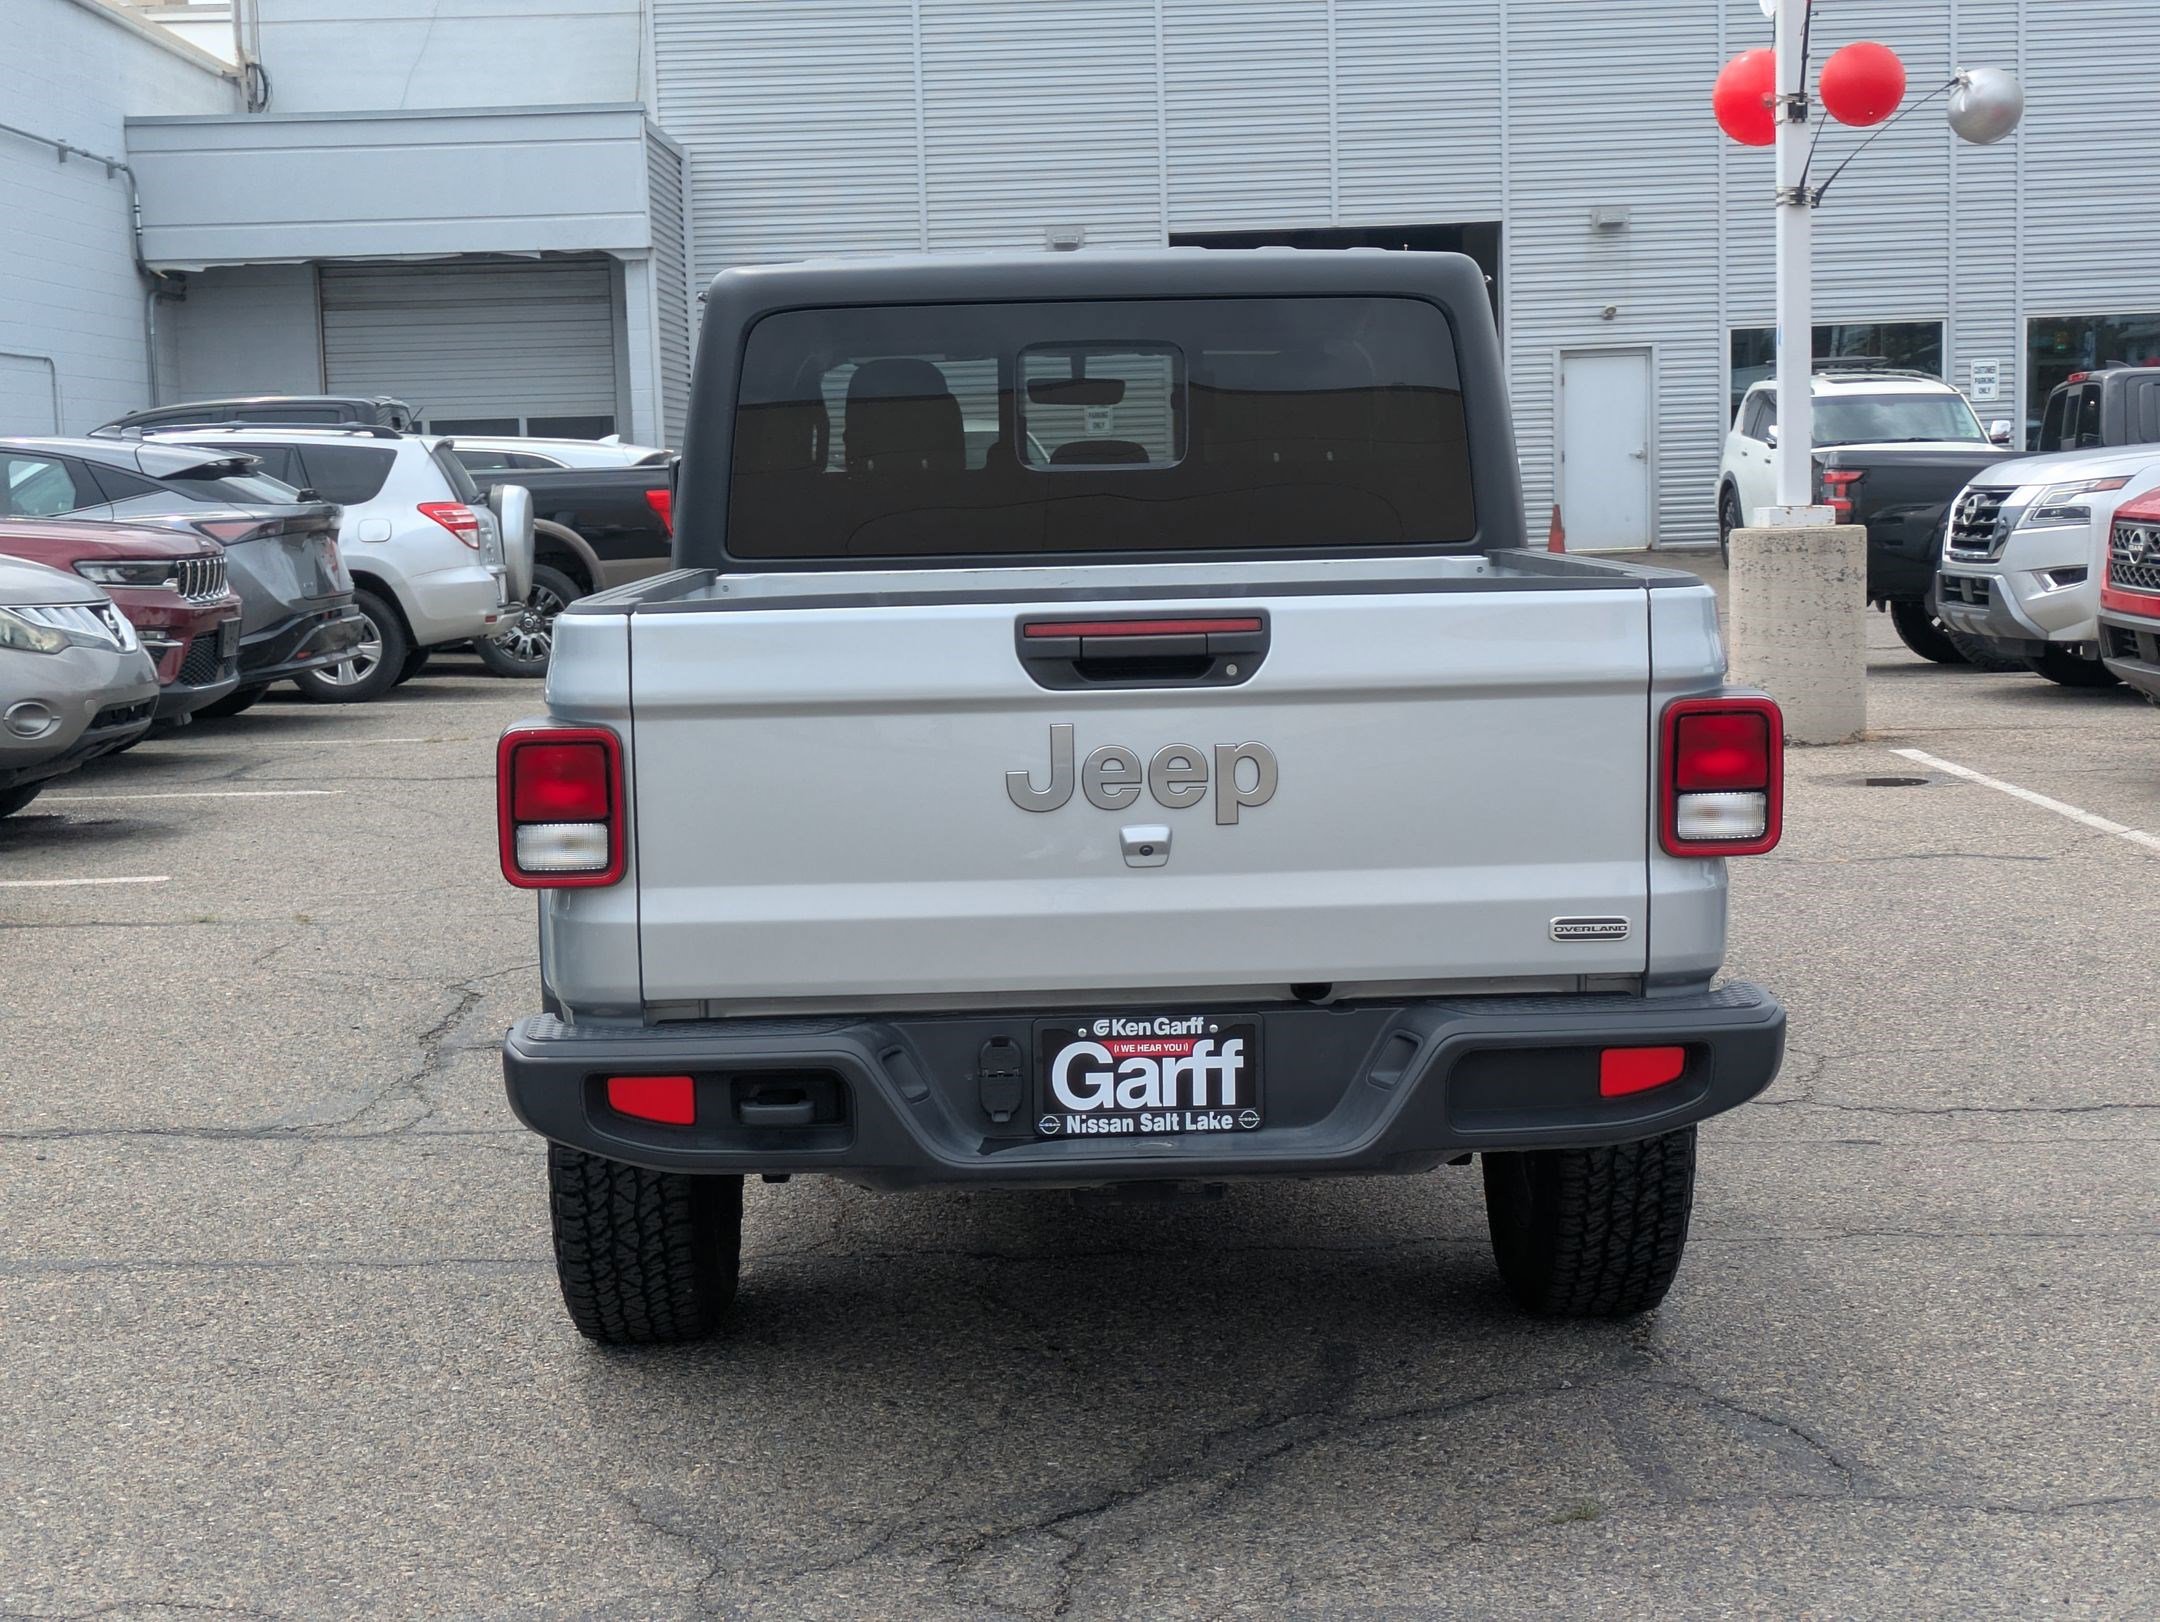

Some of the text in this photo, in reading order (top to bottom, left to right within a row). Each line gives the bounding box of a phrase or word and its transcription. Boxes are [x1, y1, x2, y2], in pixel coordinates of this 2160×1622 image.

[1006, 723, 1279, 825] Jeep
[1553, 925, 1628, 933] OVERLAND
[1112, 1017, 1204, 1036] Ken Garff
[1120, 1042, 1183, 1053] WE HEAR YOU
[1052, 1039, 1245, 1111] Garff
[1066, 1111, 1233, 1134] Nissan Salt Lake
